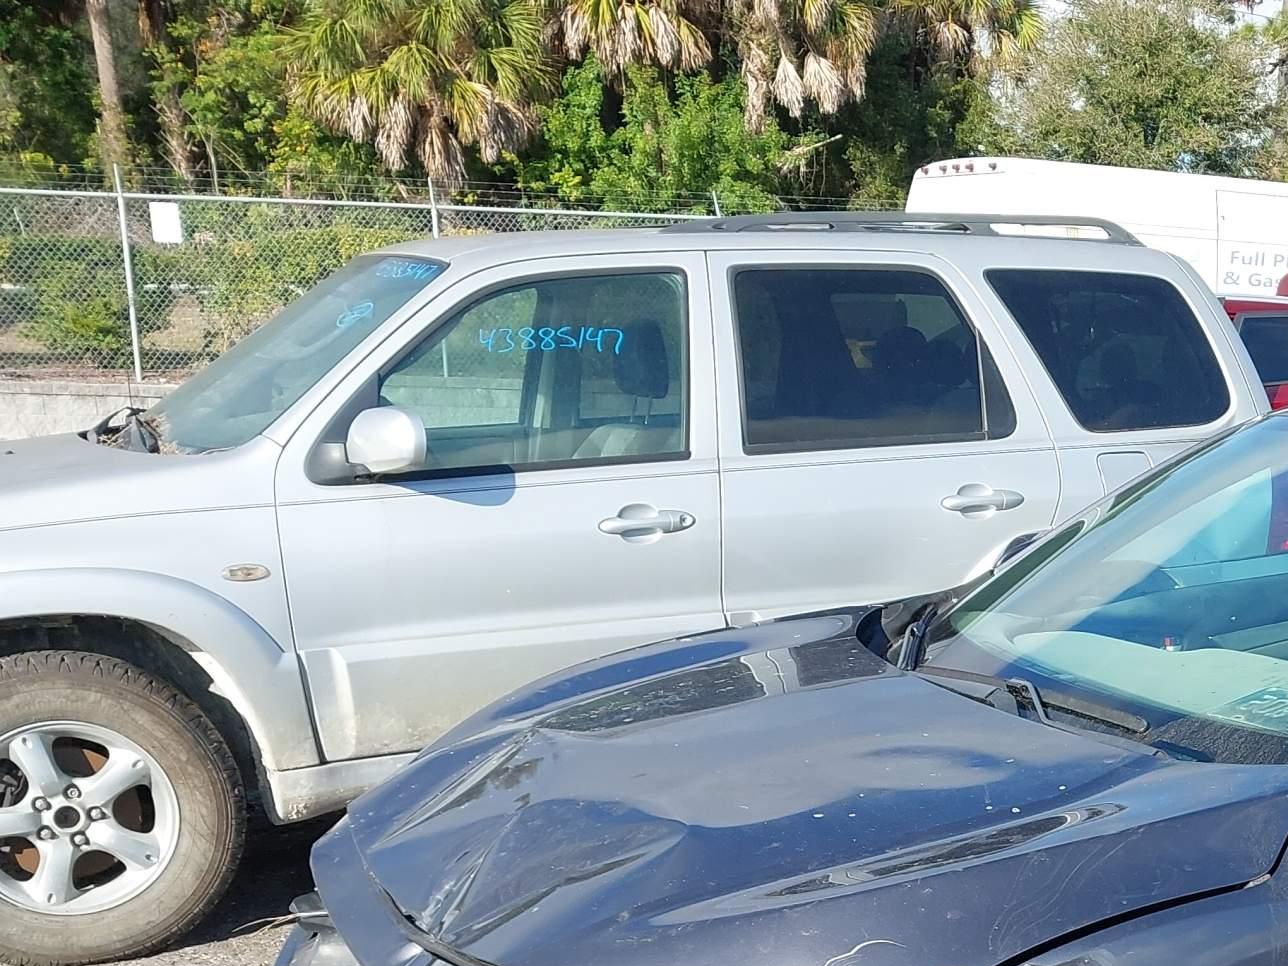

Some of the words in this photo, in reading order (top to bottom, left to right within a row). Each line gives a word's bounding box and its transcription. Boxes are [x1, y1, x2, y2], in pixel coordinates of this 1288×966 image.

[1230, 250, 1265, 266] Full
[1223, 271, 1240, 286] &
[479, 326, 624, 354] 43885147
